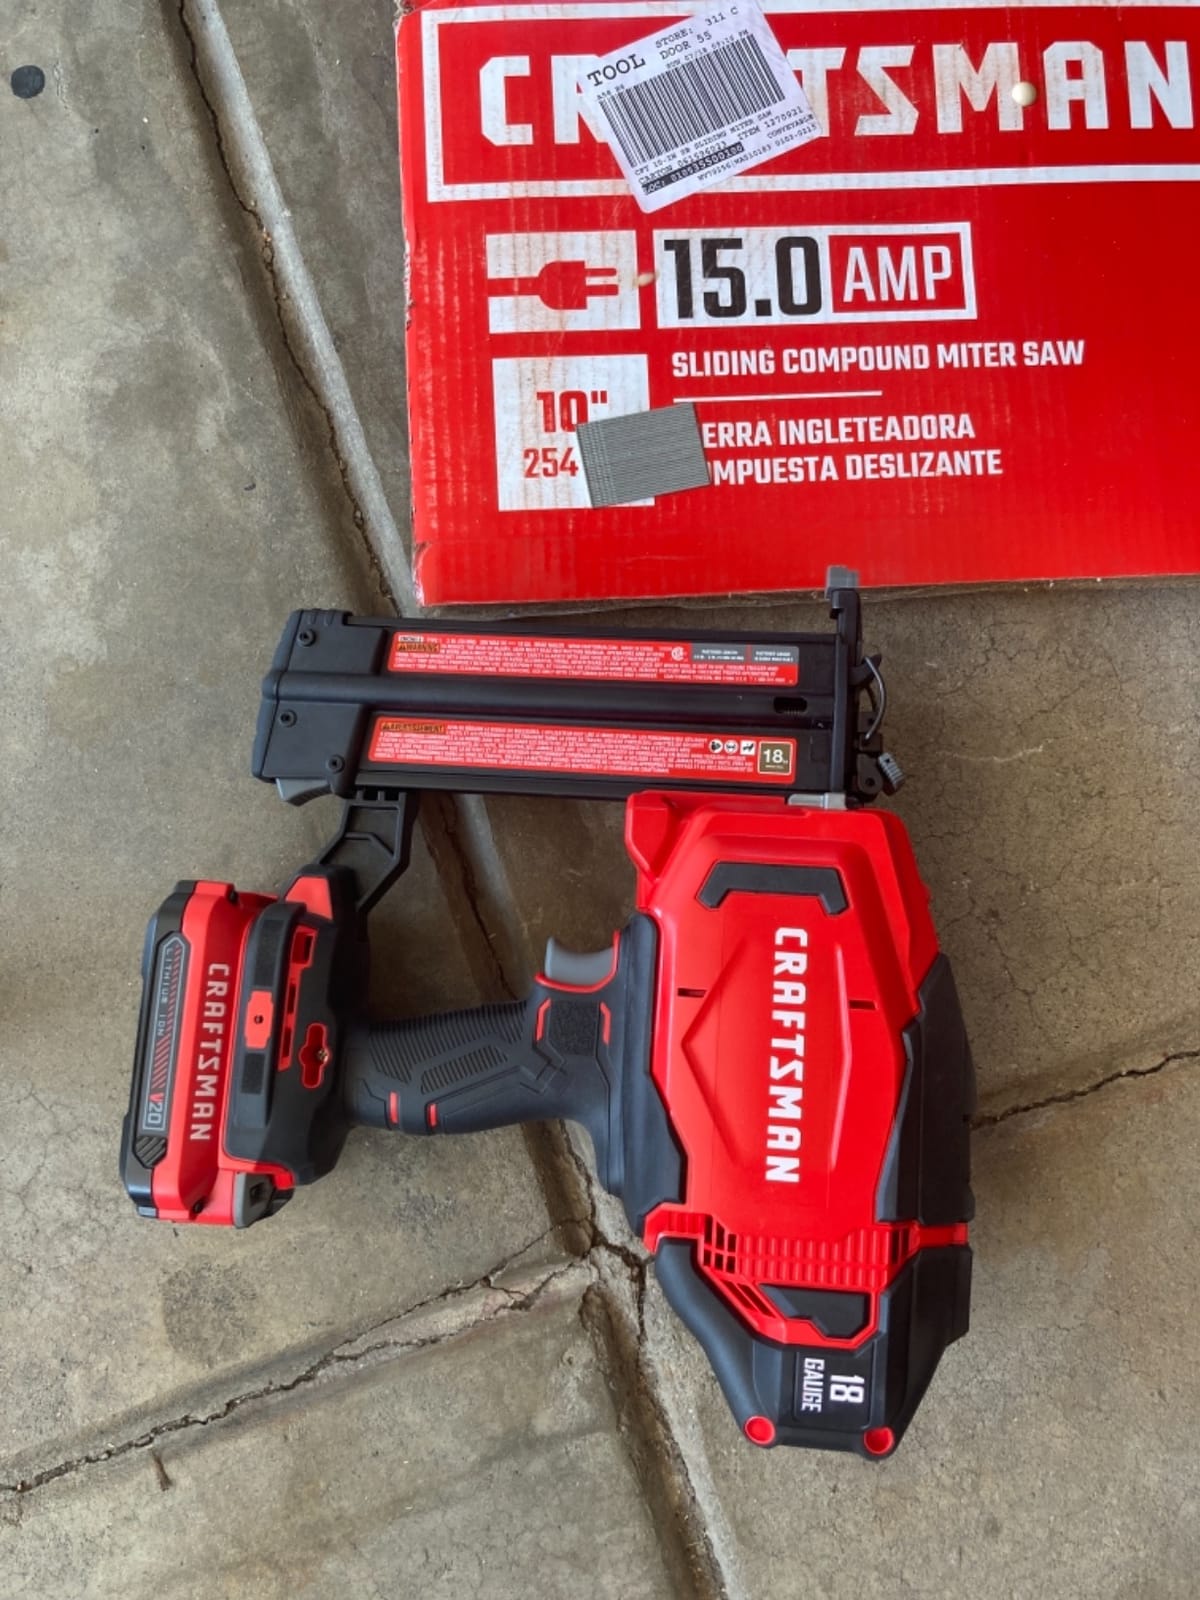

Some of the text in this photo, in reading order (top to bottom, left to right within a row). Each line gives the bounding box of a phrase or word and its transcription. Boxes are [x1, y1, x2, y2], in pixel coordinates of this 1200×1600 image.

[655, 6, 739, 48] STORE: 311 C
[659, 40, 691, 59] DOOR
[587, 54, 646, 86] TOOL
[479, 40, 1194, 146] CRTSMAN
[736, 125, 760, 141] ITEM
[664, 236, 953, 319] 15.0 AMP
[672, 340, 1085, 378] SLIDING COMPOUND MITER SAW
[536, 390, 608, 433] 10"
[702, 413, 975, 449] ERRA INGLETEADORA
[523, 447, 579, 479] 254
[709, 449, 1003, 486] MPUESTA DESLIZANTE
[763, 748, 784, 764] 18
[189, 963, 229, 1141] CRAFTSMAN
[766, 927, 808, 1183] CRAFTSMAN
[147, 1092, 164, 1125] V20
[801, 1357, 825, 1413] GAUGE
[830, 1375, 865, 1403] 18
